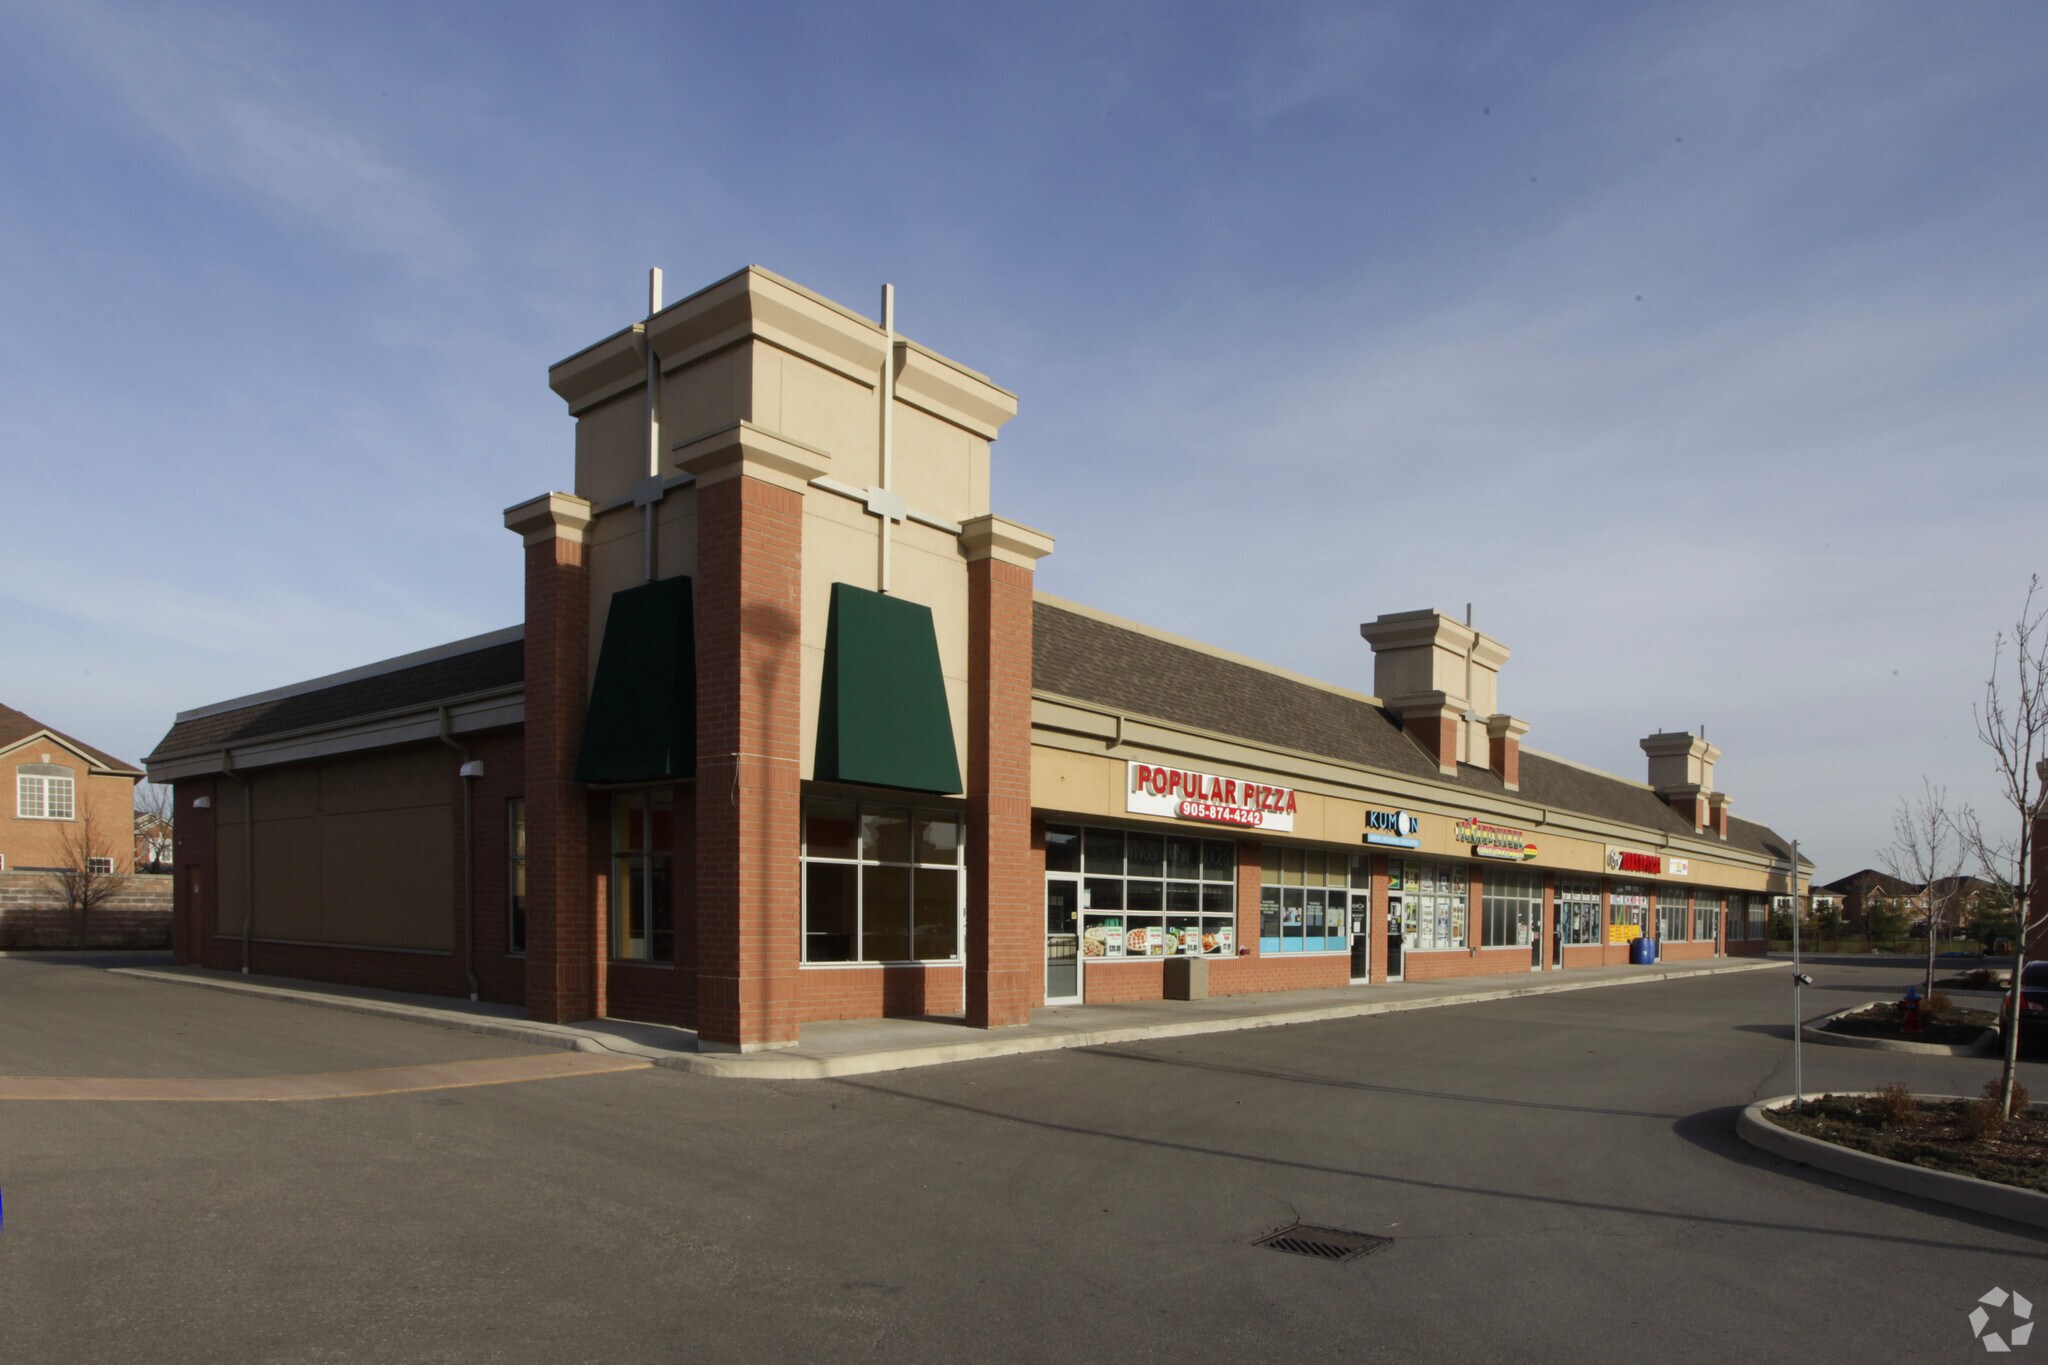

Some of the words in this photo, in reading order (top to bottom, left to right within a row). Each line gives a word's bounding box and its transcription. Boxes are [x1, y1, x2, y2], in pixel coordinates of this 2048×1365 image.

[1135, 765, 1237, 805] POPULAR
[1243, 782, 1297, 813] PIZZA
[1182, 801, 1261, 825] 905-874-4242
[1370, 811, 1419, 836] KUMON
